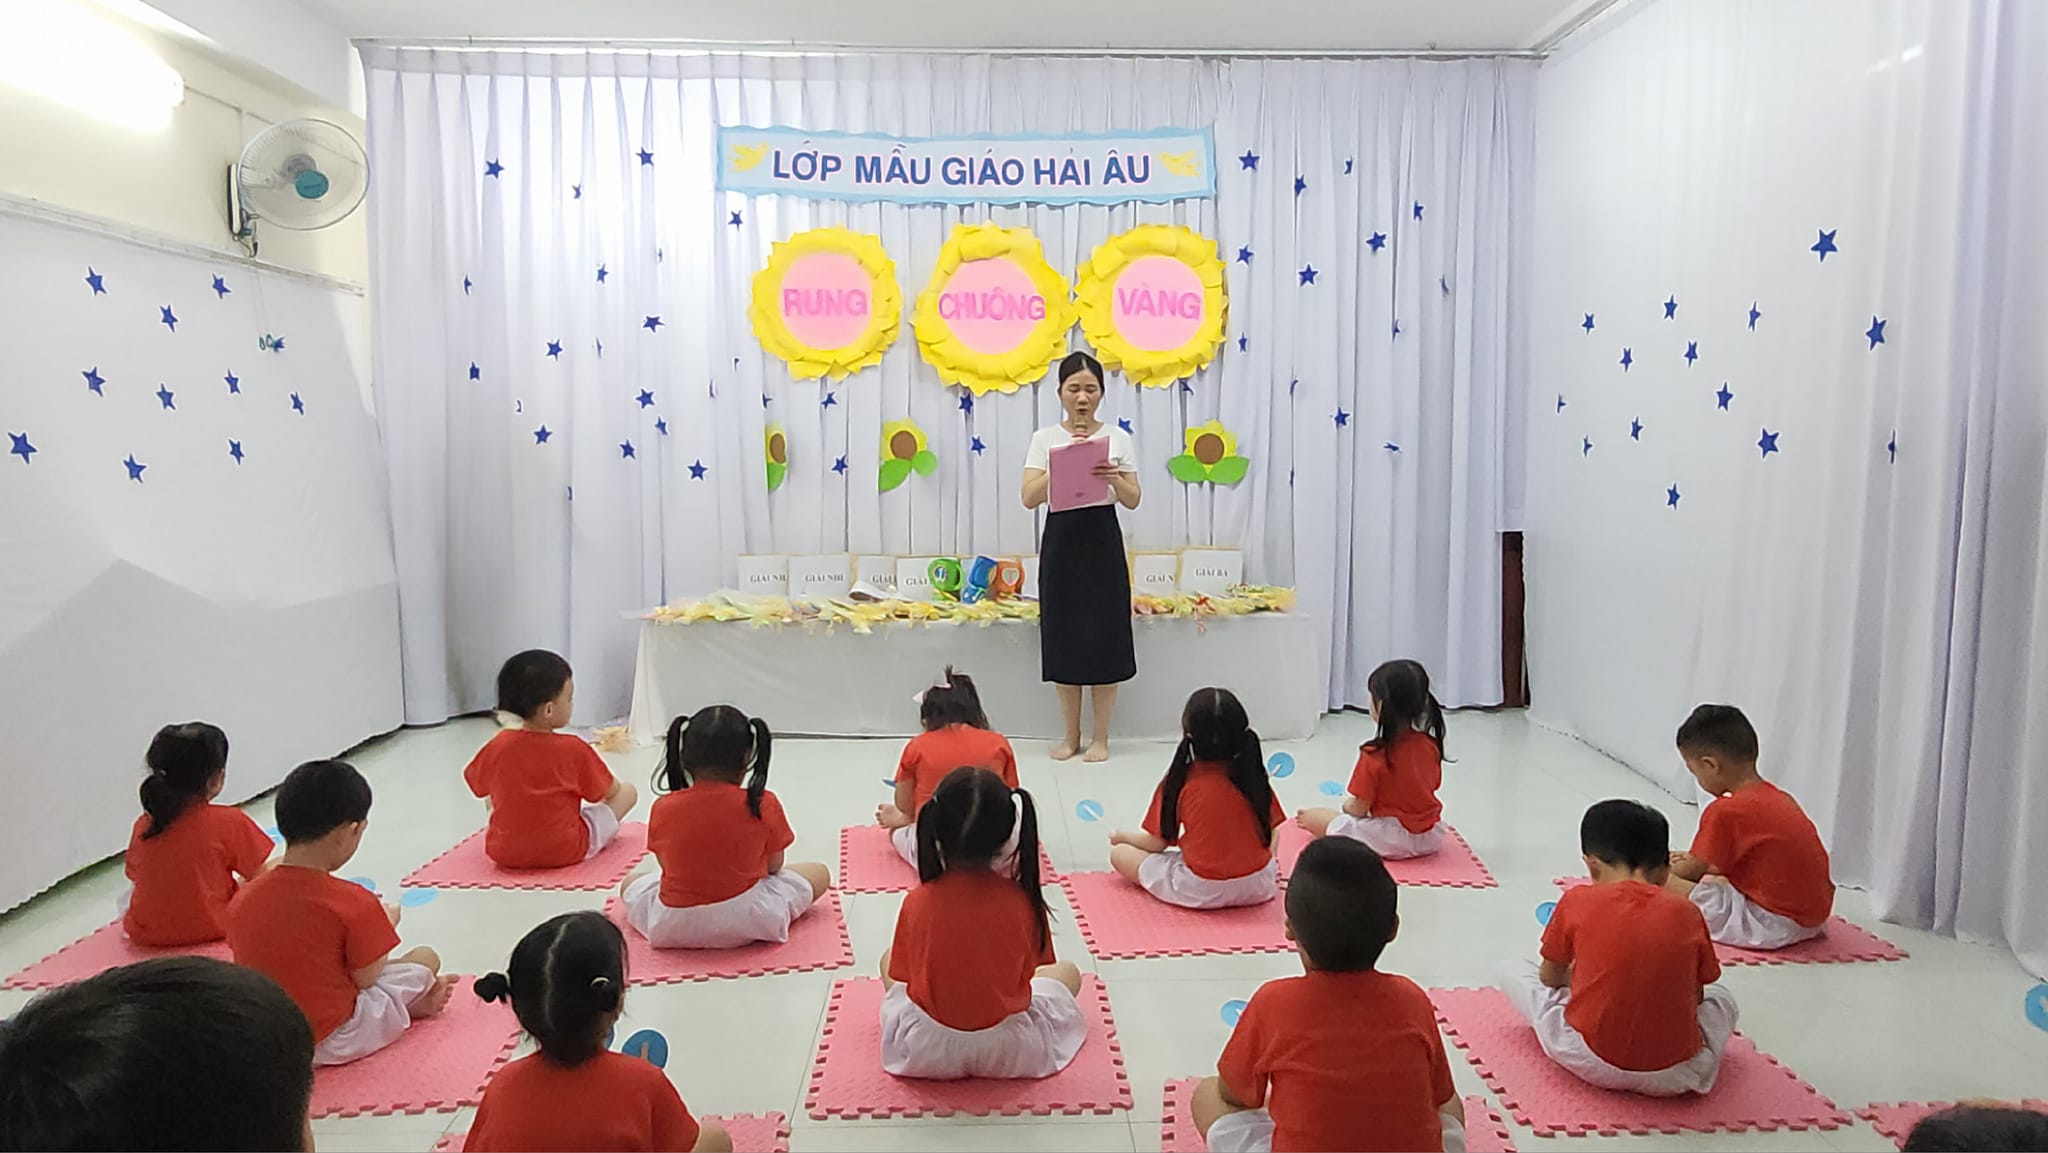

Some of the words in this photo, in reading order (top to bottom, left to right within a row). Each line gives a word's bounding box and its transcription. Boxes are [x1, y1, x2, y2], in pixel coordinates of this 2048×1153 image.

[773, 140, 842, 182] LỚP
[941, 148, 1025, 185] GIÁO
[1034, 147, 1091, 186] HẢI
[1103, 149, 1150, 185] ÂU
[784, 288, 868, 317] RUNG
[938, 286, 1046, 321] CHUÔNG
[1117, 282, 1201, 320] VÀNG
